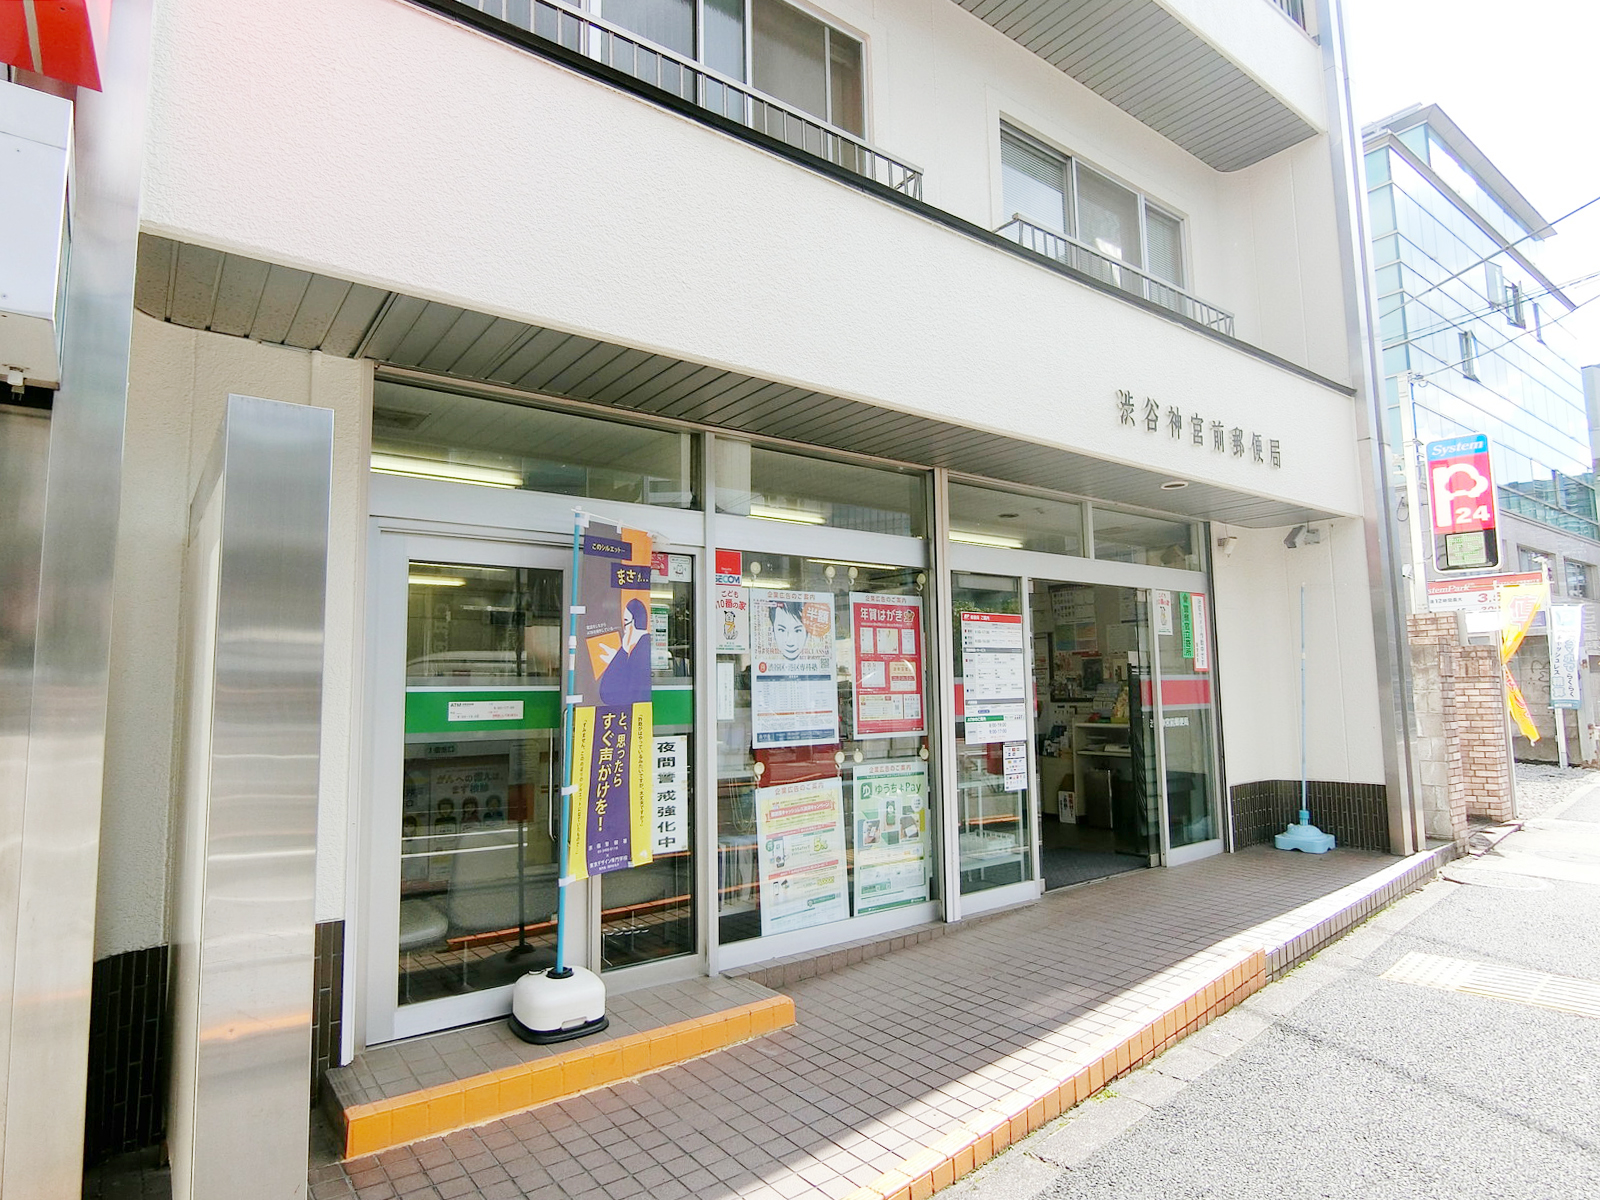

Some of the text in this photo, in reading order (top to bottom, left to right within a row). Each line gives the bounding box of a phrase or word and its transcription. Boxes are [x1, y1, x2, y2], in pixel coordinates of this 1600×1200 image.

[1116, 389, 1281, 469] 渋谷神宮前郵便局
[1432, 441, 1483, 456] System
[1455, 505, 1490, 524] 24
[721, 590, 739, 598] こども
[767, 591, 815, 600] 企業広告のご案内
[865, 594, 907, 604] 企業広告のご案内
[807, 607, 829, 624] 半額
[860, 607, 902, 622] 年賀はがき
[613, 712, 628, 788] と、思ったら
[868, 764, 911, 773] 企業広告のご案内
[657, 741, 677, 848] 夜間警戒強化中
[775, 782, 824, 795] 企業広告のご案内
[875, 781, 922, 795] ゆうちょPay
